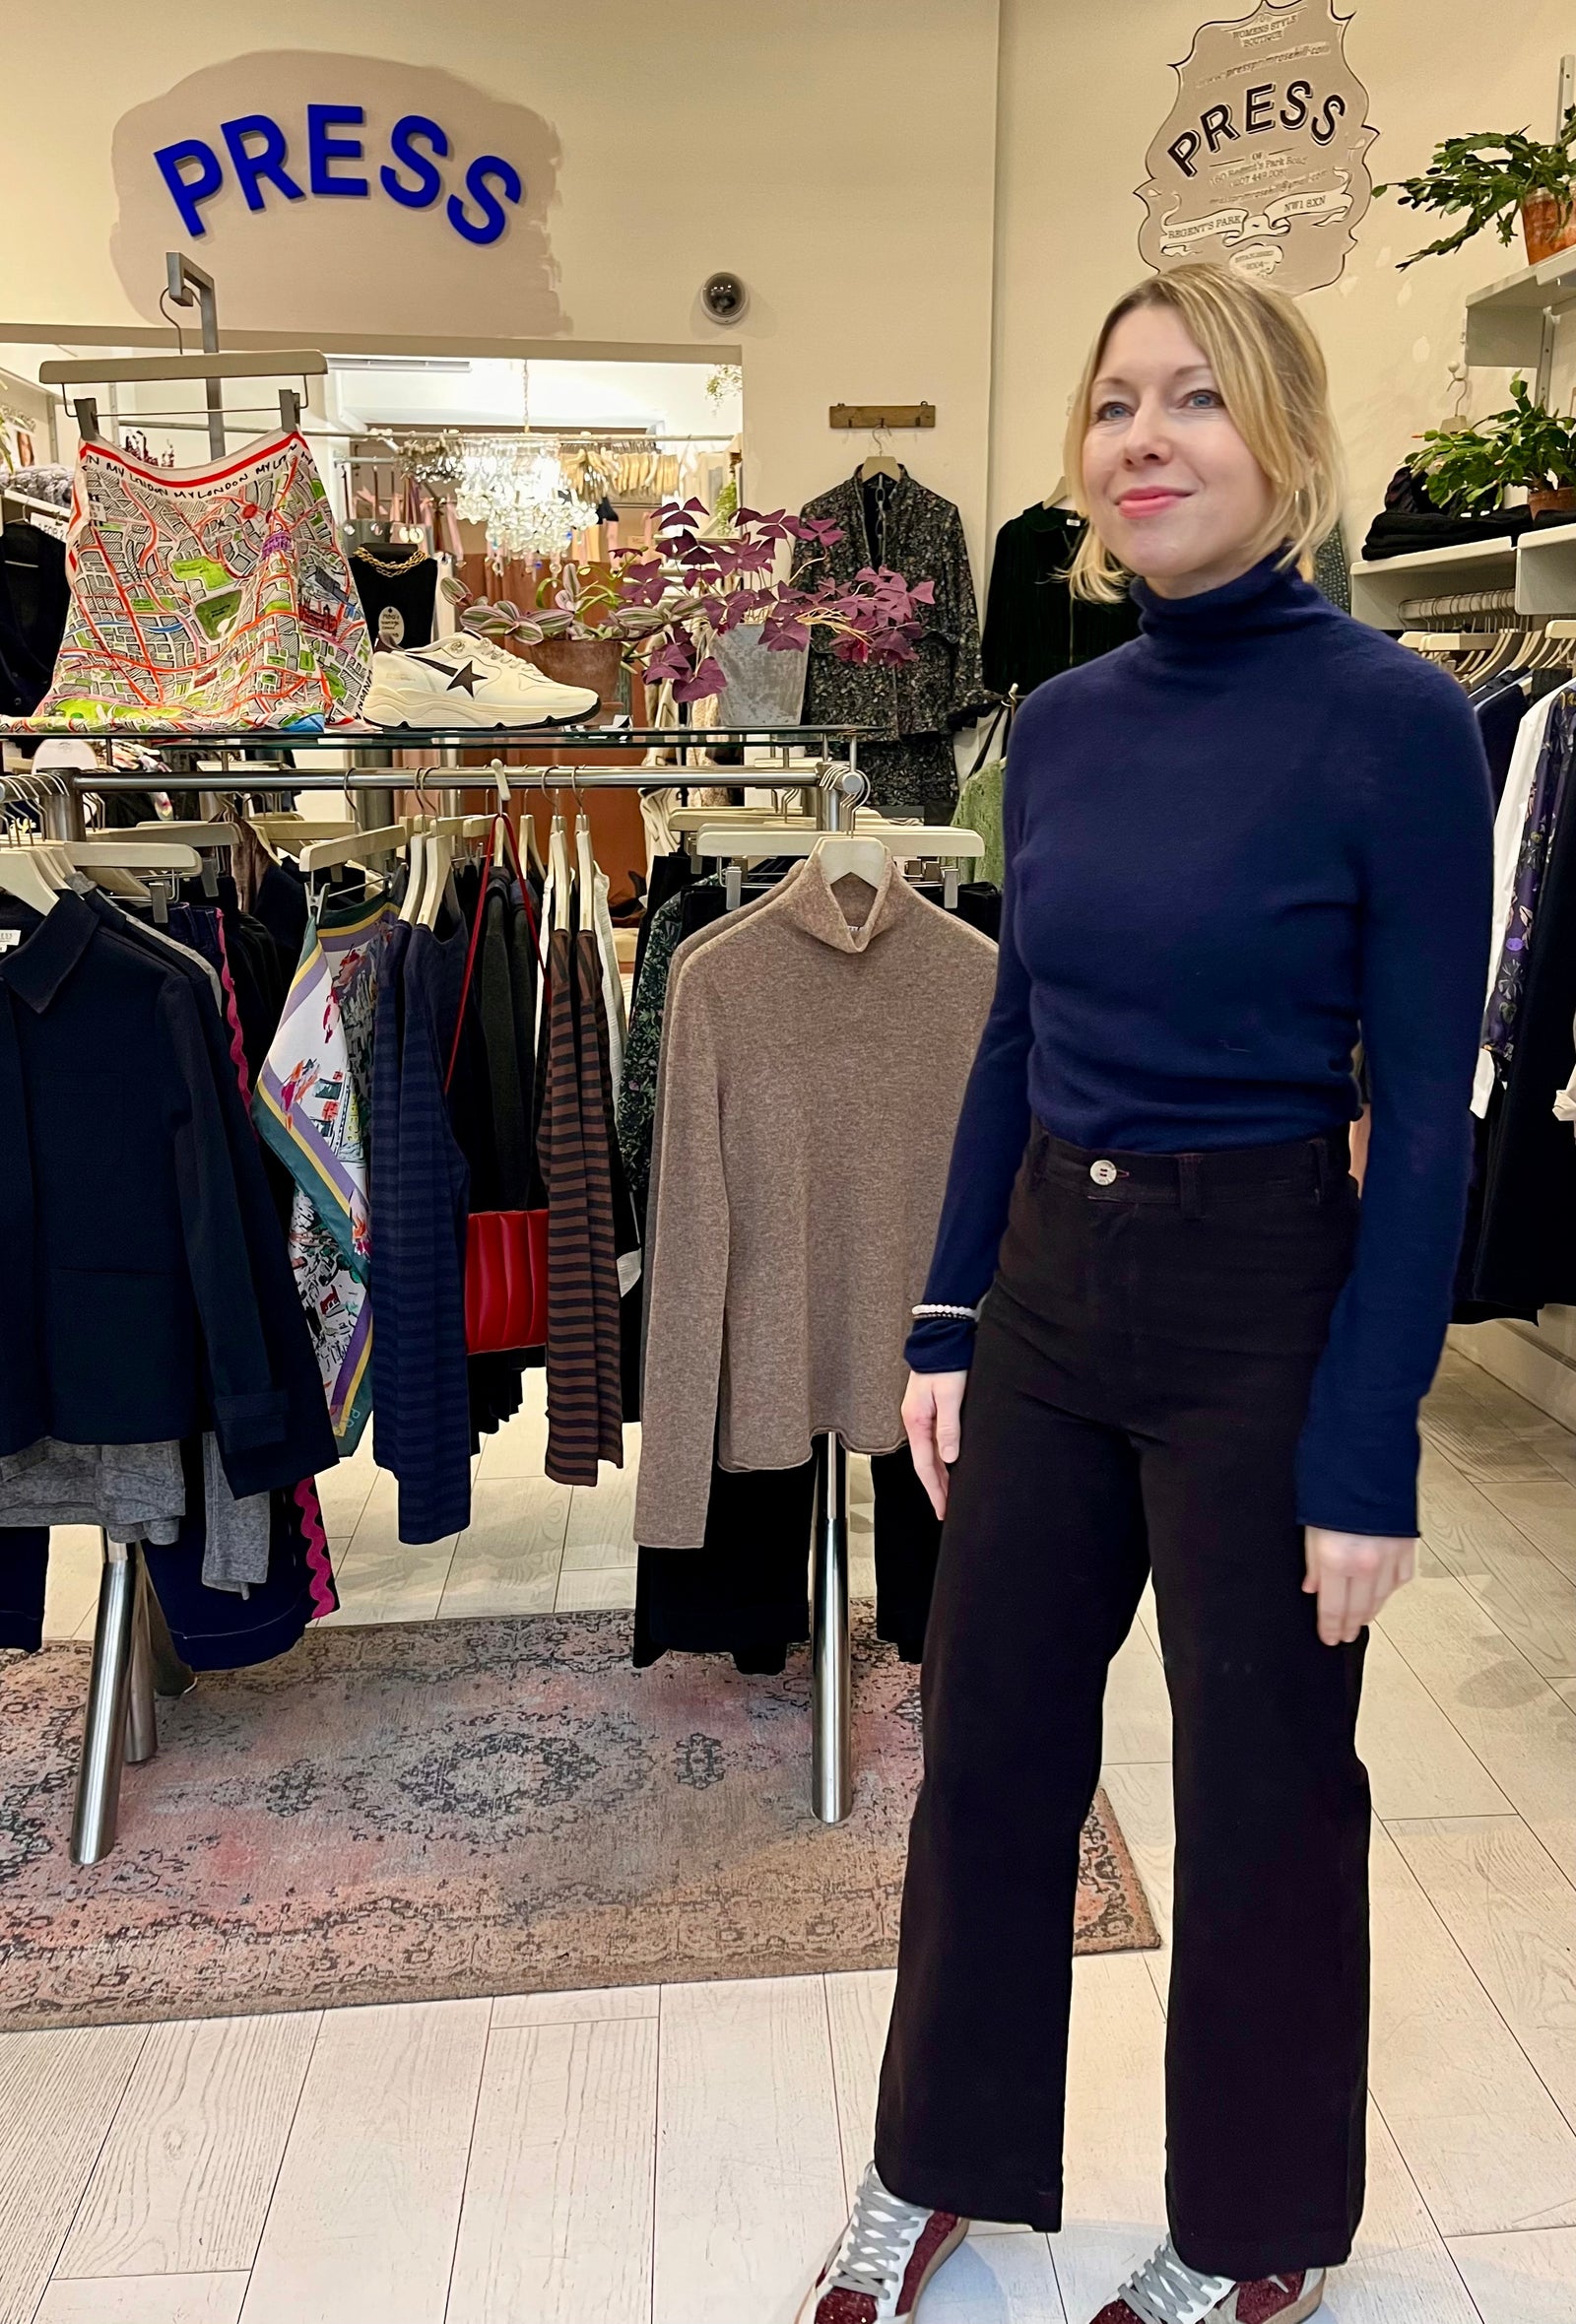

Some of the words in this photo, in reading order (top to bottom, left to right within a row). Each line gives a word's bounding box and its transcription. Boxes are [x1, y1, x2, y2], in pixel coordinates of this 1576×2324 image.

[1271, 15, 1297, 31] STYLE
[1167, 81, 1346, 177] PRESS
[154, 103, 522, 246] PRESS
[1283, 199, 1304, 213] NW1
[1305, 195, 1327, 209] 8XN
[1168, 220, 1215, 239] REGENT'S
[1215, 215, 1242, 229] PARK
[197, 473, 248, 499] LONDON
[255, 461, 271, 475] MY
